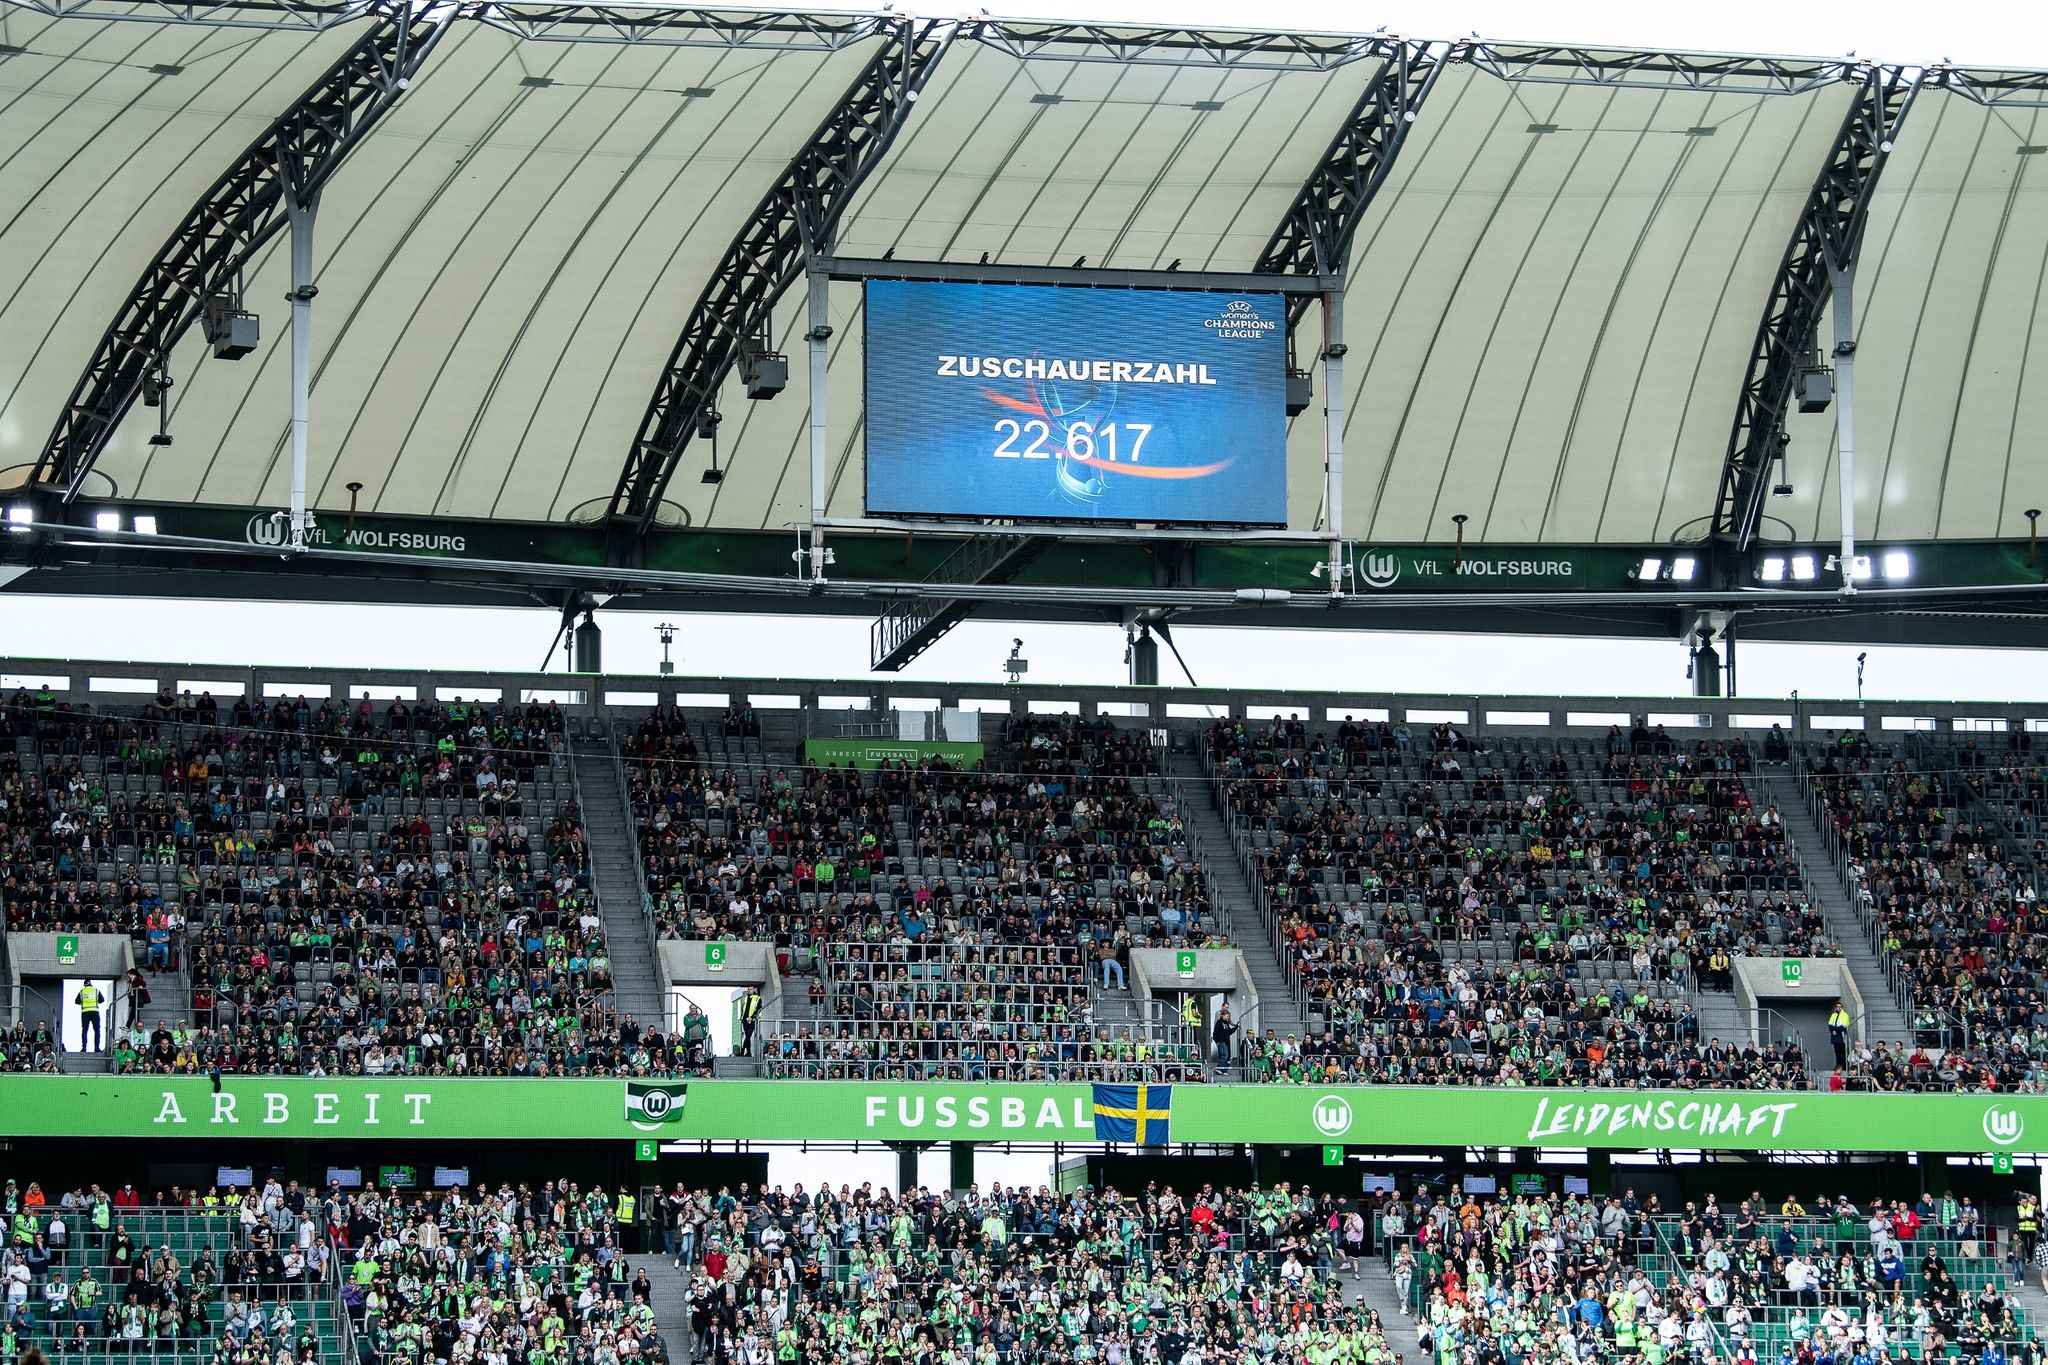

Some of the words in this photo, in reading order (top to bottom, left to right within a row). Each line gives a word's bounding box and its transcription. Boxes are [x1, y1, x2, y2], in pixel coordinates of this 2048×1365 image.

[1204, 319, 1275, 330] CHAMPIONS
[1218, 329, 1262, 338] LEAGUE
[937, 356, 1217, 385] ZUSCHAUERZAHL
[993, 419, 1153, 462] 22.617
[303, 527, 332, 544] VfL
[345, 529, 466, 551] WOLFSBURG
[1413, 560, 1442, 575] VfL
[1454, 560, 1572, 576] WOLFSBURG
[63, 940, 73, 952] 4
[711, 948, 720, 960] 6
[1182, 956, 1191, 967] 8
[1784, 964, 1800, 976] 10
[152, 1091, 433, 1125] ARBEIT
[865, 1096, 1094, 1129] FUSSBAL
[1528, 1097, 1798, 1141] LEIDENSCHAFT
[642, 1144, 651, 1156] 5
[1330, 1149, 1338, 1161] 7
[1998, 1157, 2008, 1169] 9
